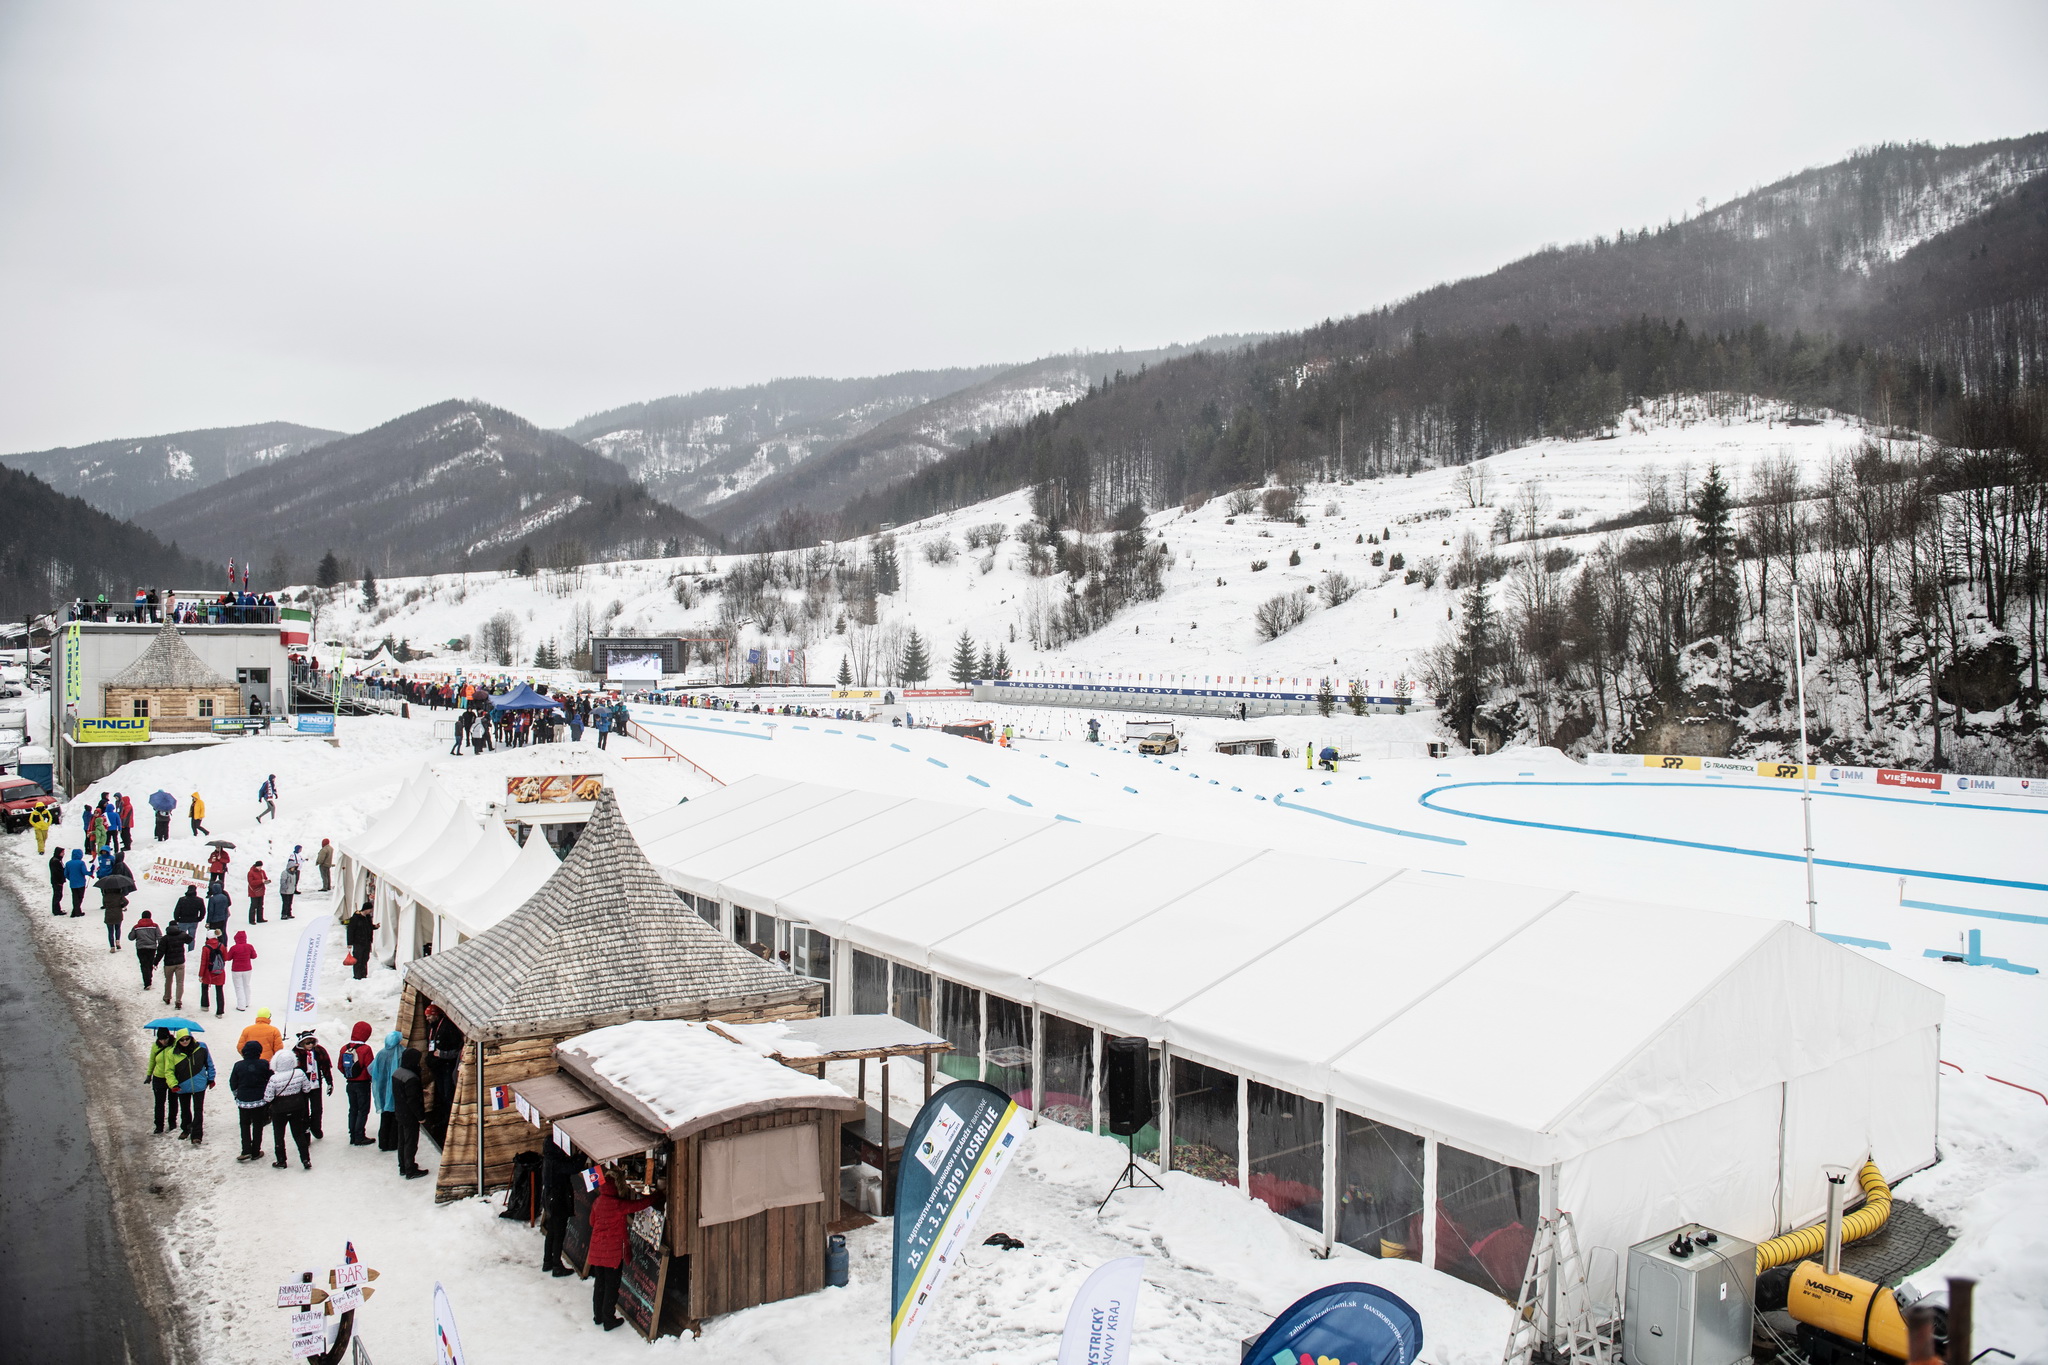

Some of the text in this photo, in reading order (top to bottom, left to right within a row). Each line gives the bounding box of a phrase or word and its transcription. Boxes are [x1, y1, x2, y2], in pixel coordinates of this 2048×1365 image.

[1083, 686, 1183, 695] BIATLONOVÉ
[1194, 690, 1282, 699] CENTRUM
[82, 720, 145, 730] PINGU
[300, 716, 333, 724] PINGU
[1661, 757, 1684, 769] SPP
[1711, 762, 1755, 772] TRANSPETROL
[1775, 765, 1798, 778] SPP
[1842, 770, 1864, 780] IMM
[1883, 772, 1936, 785] VIESSMANN
[1970, 780, 1995, 790] IMM
[302, 938, 315, 991] BANSKOBYSTRICKÝ
[907, 1202, 932, 1244] MAJSTROVSTVÁ
[930, 1186, 942, 1205] SVETA
[938, 1158, 956, 1190] JUNIOROV
[956, 1127, 972, 1154] MLÁDEŽE
[970, 1098, 988, 1127] BIATLONE
[908, 1248, 924, 1270] 25.
[918, 1236, 932, 1247] 1.
[928, 1216, 942, 1229] 3.
[936, 1202, 950, 1216] 2.
[943, 1168, 965, 1202] 2019
[964, 1106, 999, 1160] OSRBLIE
[338, 1264, 366, 1284] BAR
[1805, 1279, 1854, 1302] MASTER
[1107, 1300, 1120, 1331] KRAJ
